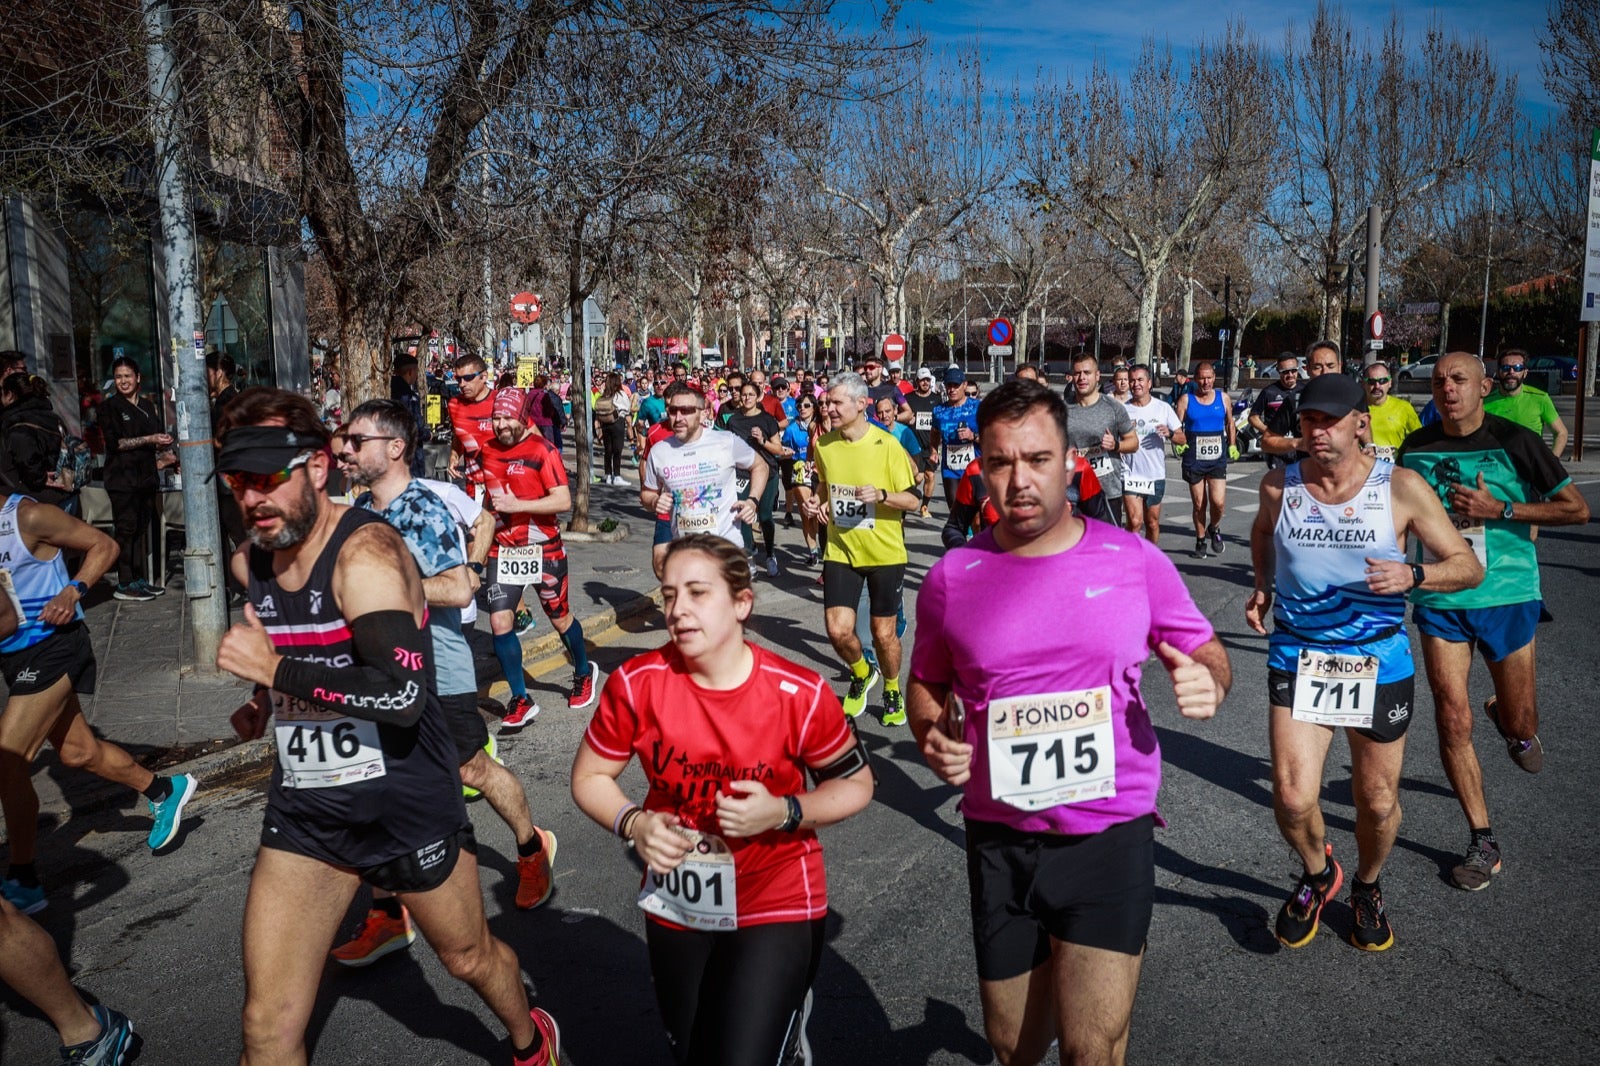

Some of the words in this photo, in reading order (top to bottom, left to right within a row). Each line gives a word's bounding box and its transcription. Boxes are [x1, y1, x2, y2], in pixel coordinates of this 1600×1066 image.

[920, 418, 932, 426] 84
[1201, 445, 1219, 455] 659
[951, 453, 971, 464] 274
[835, 500, 868, 519] 354
[1288, 527, 1376, 542] MARACENA
[500, 560, 539, 575] 3038
[1317, 660, 1363, 673] FONDO
[1311, 680, 1361, 709] 711
[1016, 701, 1090, 727] FONDO
[287, 721, 360, 763] 416
[1011, 732, 1099, 786] 715
